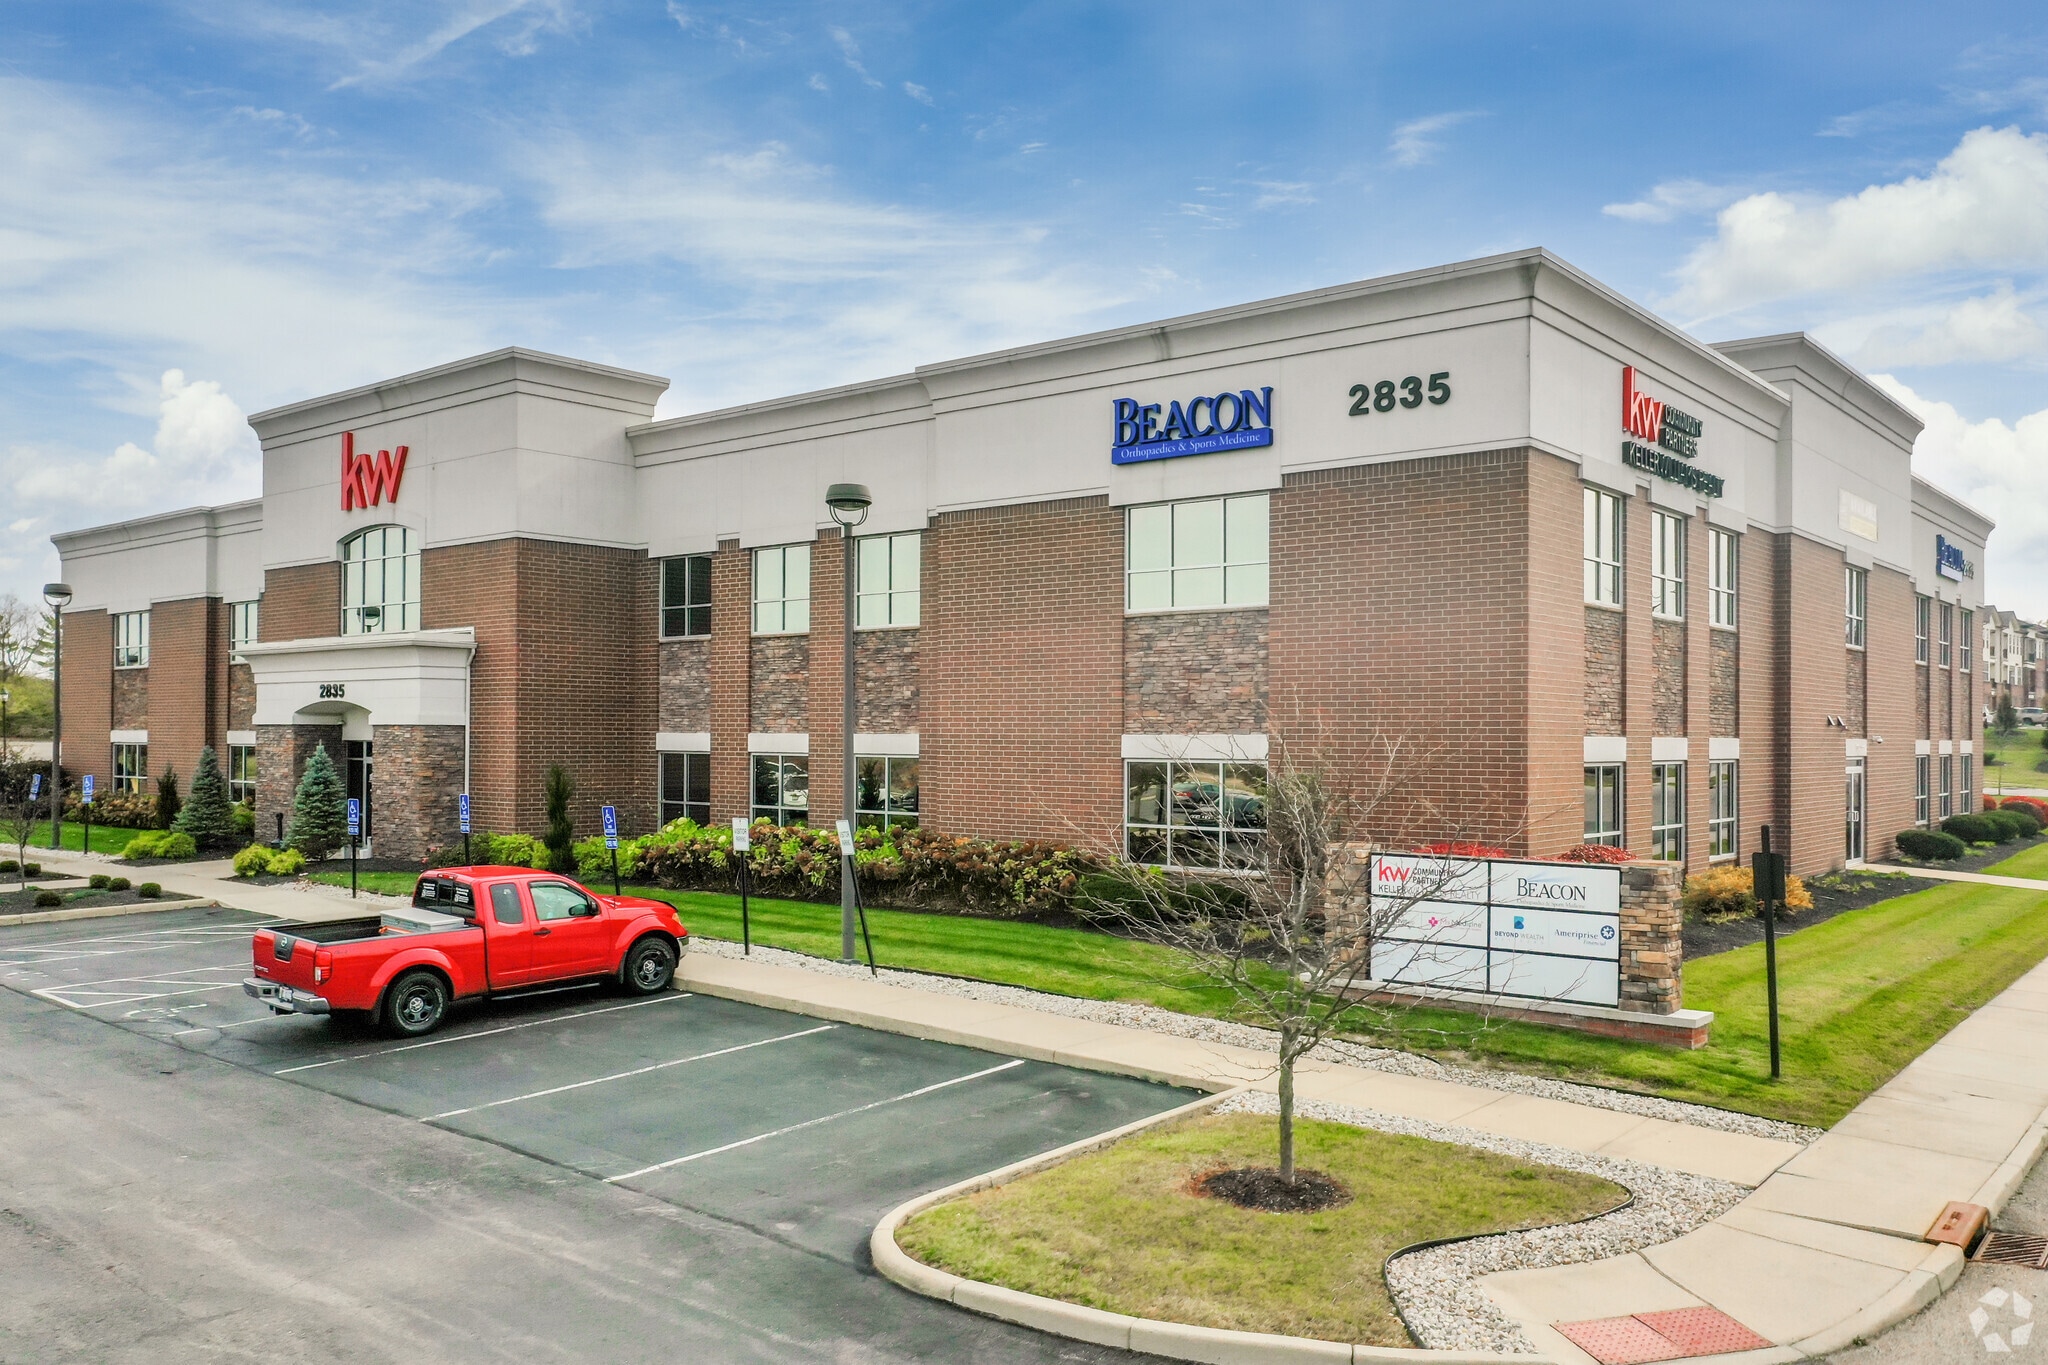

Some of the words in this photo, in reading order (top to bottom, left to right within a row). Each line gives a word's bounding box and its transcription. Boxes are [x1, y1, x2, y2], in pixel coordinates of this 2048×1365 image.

[1348, 371, 1451, 416] 2835
[1622, 366, 1664, 443] kw
[1112, 386, 1274, 447] BEACON
[1121, 444, 1176, 459] Orthopaedics
[1178, 442, 1187, 451] &
[1190, 439, 1217, 453] Sports
[1219, 432, 1261, 446] Medicine
[1658, 427, 1698, 458] PARTNERS
[341, 431, 409, 512] kw
[319, 683, 345, 699] 2835
[1379, 858, 1410, 882] kw
[1517, 878, 1586, 901] BEACON
[1494, 930, 1519, 939] BEYOND
[1521, 932, 1545, 941] WEALTH
[1555, 928, 1599, 940] Ameriprise
